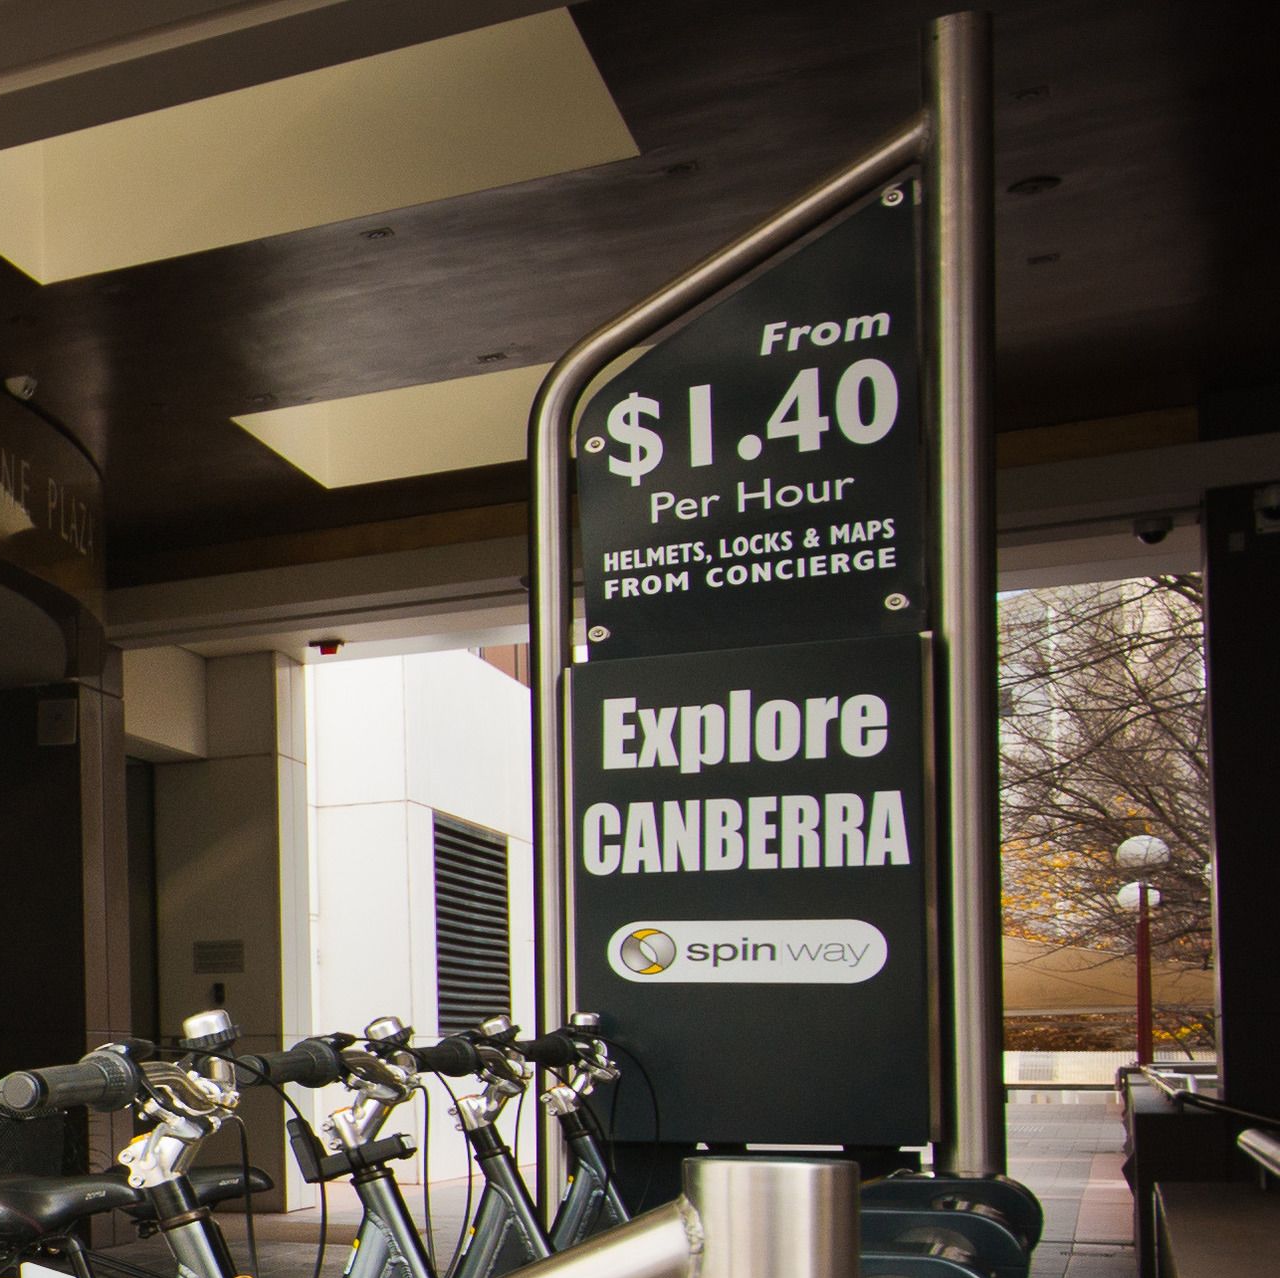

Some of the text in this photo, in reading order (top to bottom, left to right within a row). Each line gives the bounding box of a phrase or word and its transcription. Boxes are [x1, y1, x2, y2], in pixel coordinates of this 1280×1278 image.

[760, 311, 891, 356] From
[606, 358, 899, 487] $1.40
[651, 475, 855, 524] Per Hour
[603, 518, 896, 573] HELMETS, LOCKS & MAPS
[604, 547, 897, 600] FROM CONCIERGE
[602, 689, 889, 774] Explore
[582, 790, 911, 876] CANBERRA
[686, 937, 870, 968] spin way
